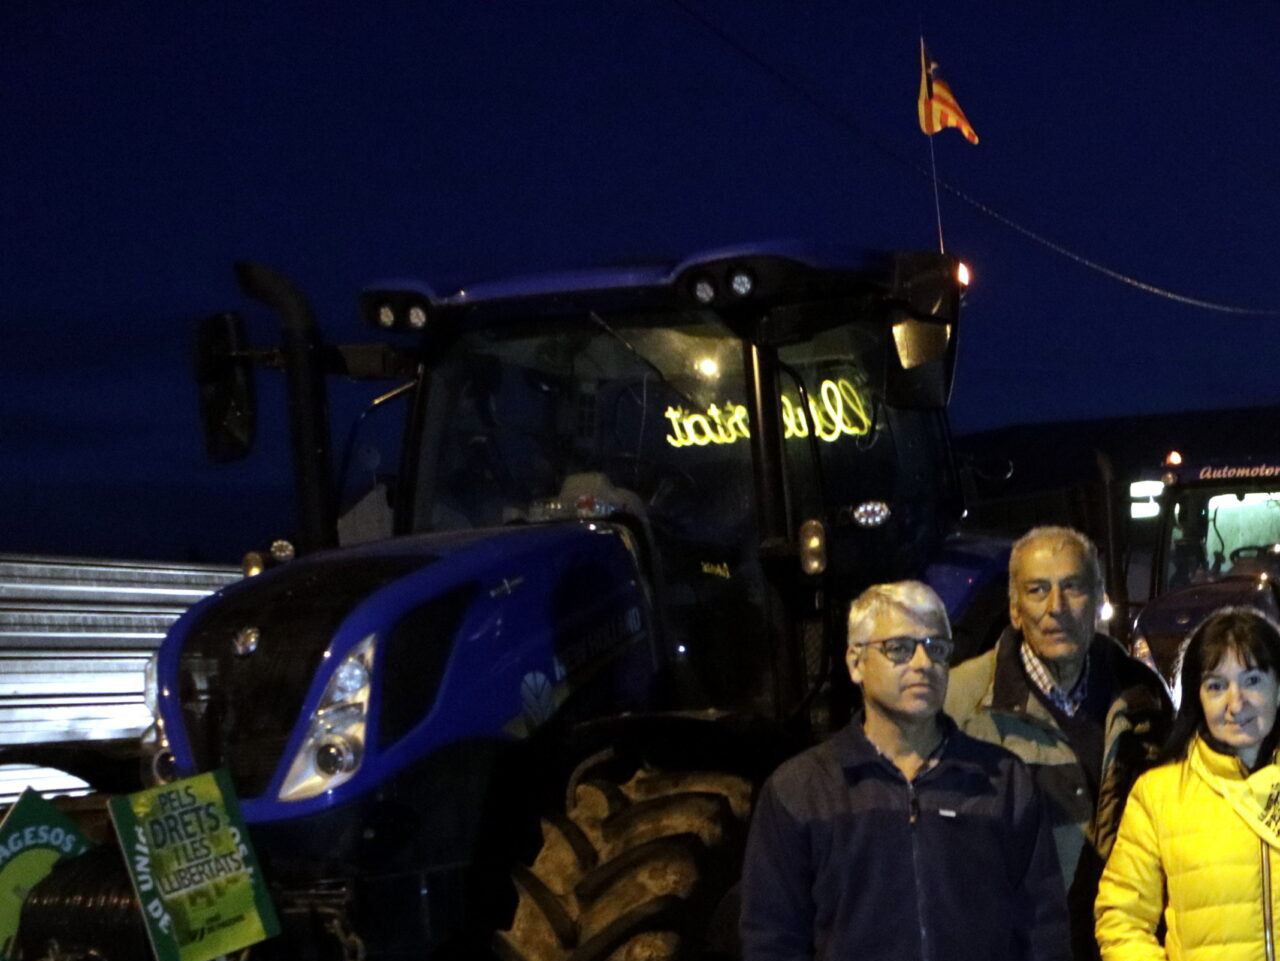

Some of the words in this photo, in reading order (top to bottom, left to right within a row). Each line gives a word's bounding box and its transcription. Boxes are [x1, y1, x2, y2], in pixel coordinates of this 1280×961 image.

[157, 785, 196, 812] PELS
[0, 824, 77, 864] AGESOS
[150, 803, 220, 849] DRETS
[184, 837, 212, 862] LES
[158, 853, 243, 896] LLIBERTATS
